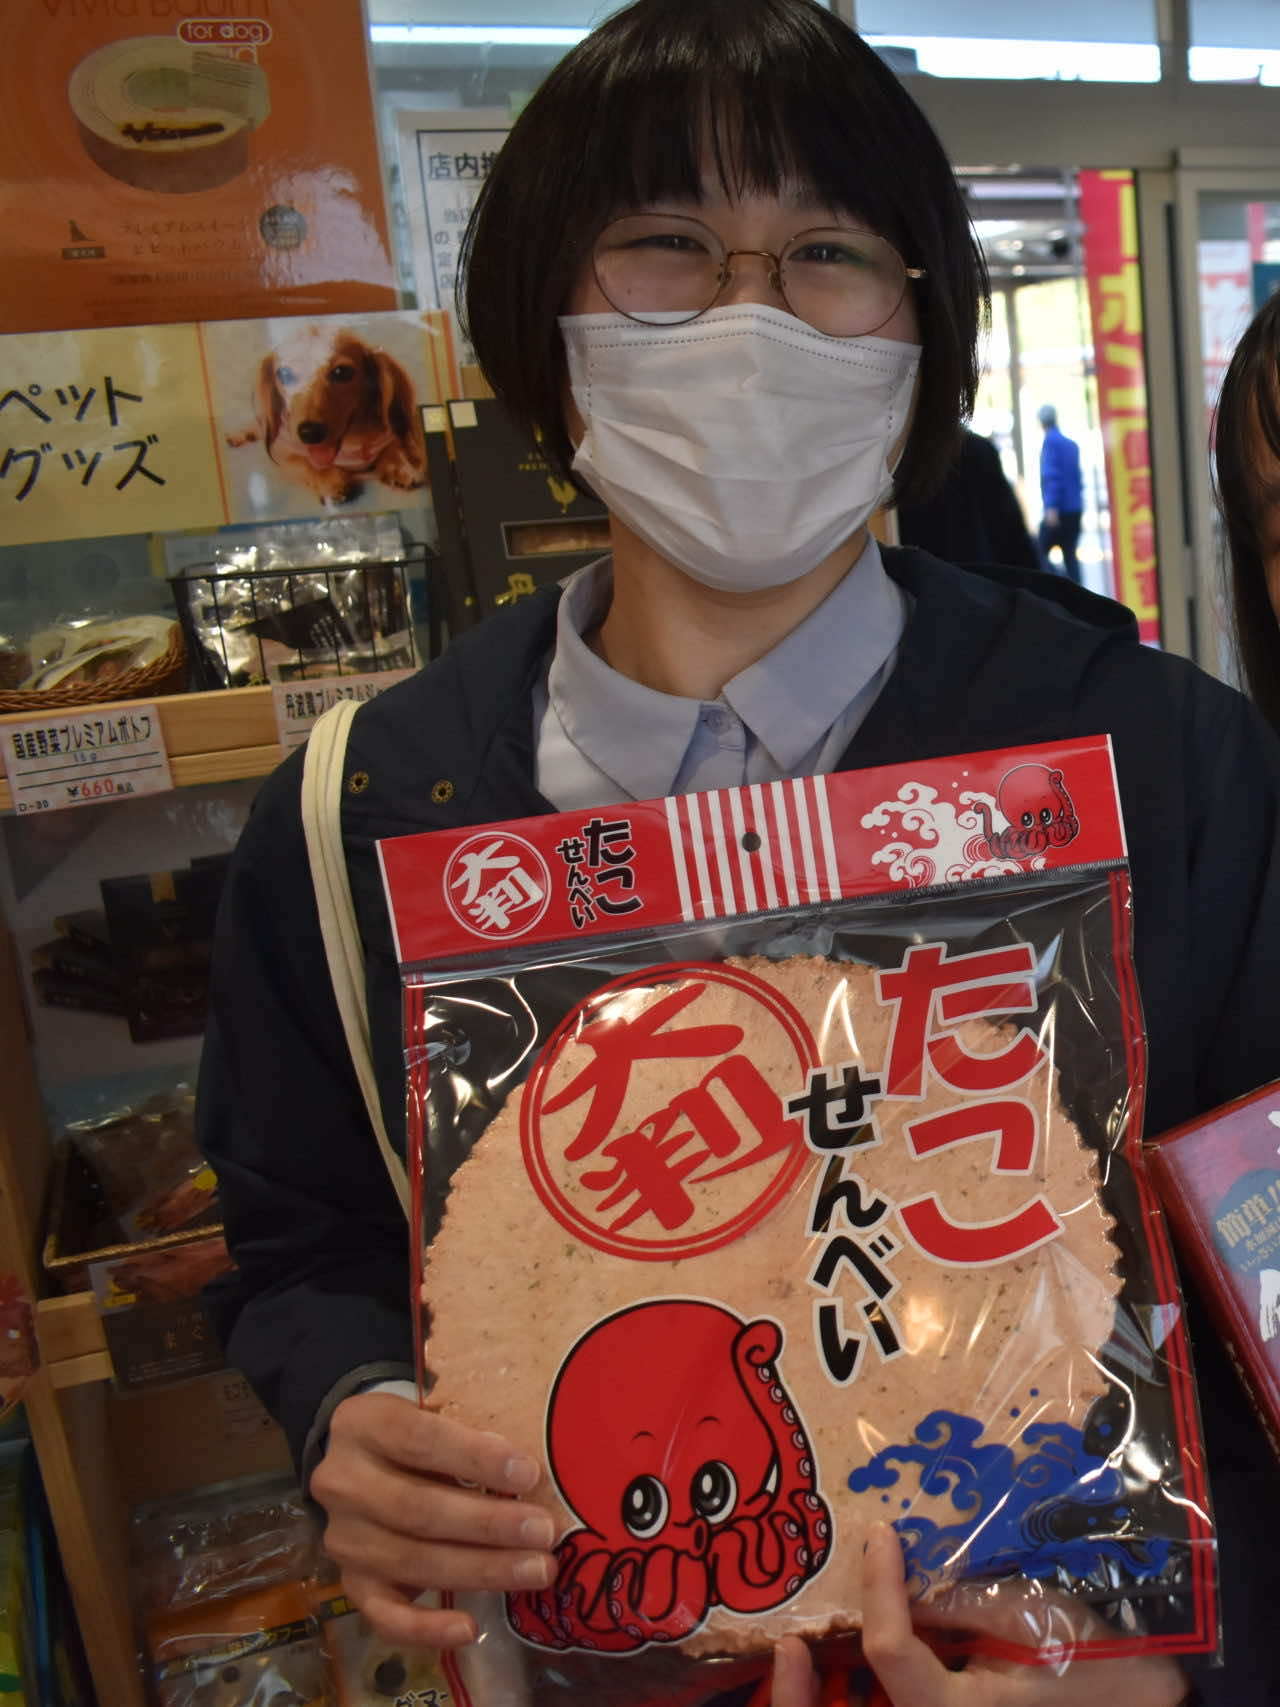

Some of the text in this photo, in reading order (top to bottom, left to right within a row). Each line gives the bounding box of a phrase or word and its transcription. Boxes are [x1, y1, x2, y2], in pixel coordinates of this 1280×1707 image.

[219, 21, 263, 44] dog
[0, 375, 142, 427] ペット
[0, 433, 165, 502] グッズ
[556, 837, 598, 930] せんべい
[583, 817, 644, 915] たこ
[874, 942, 1066, 1267] たこ
[784, 1065, 905, 1386] せんべい
